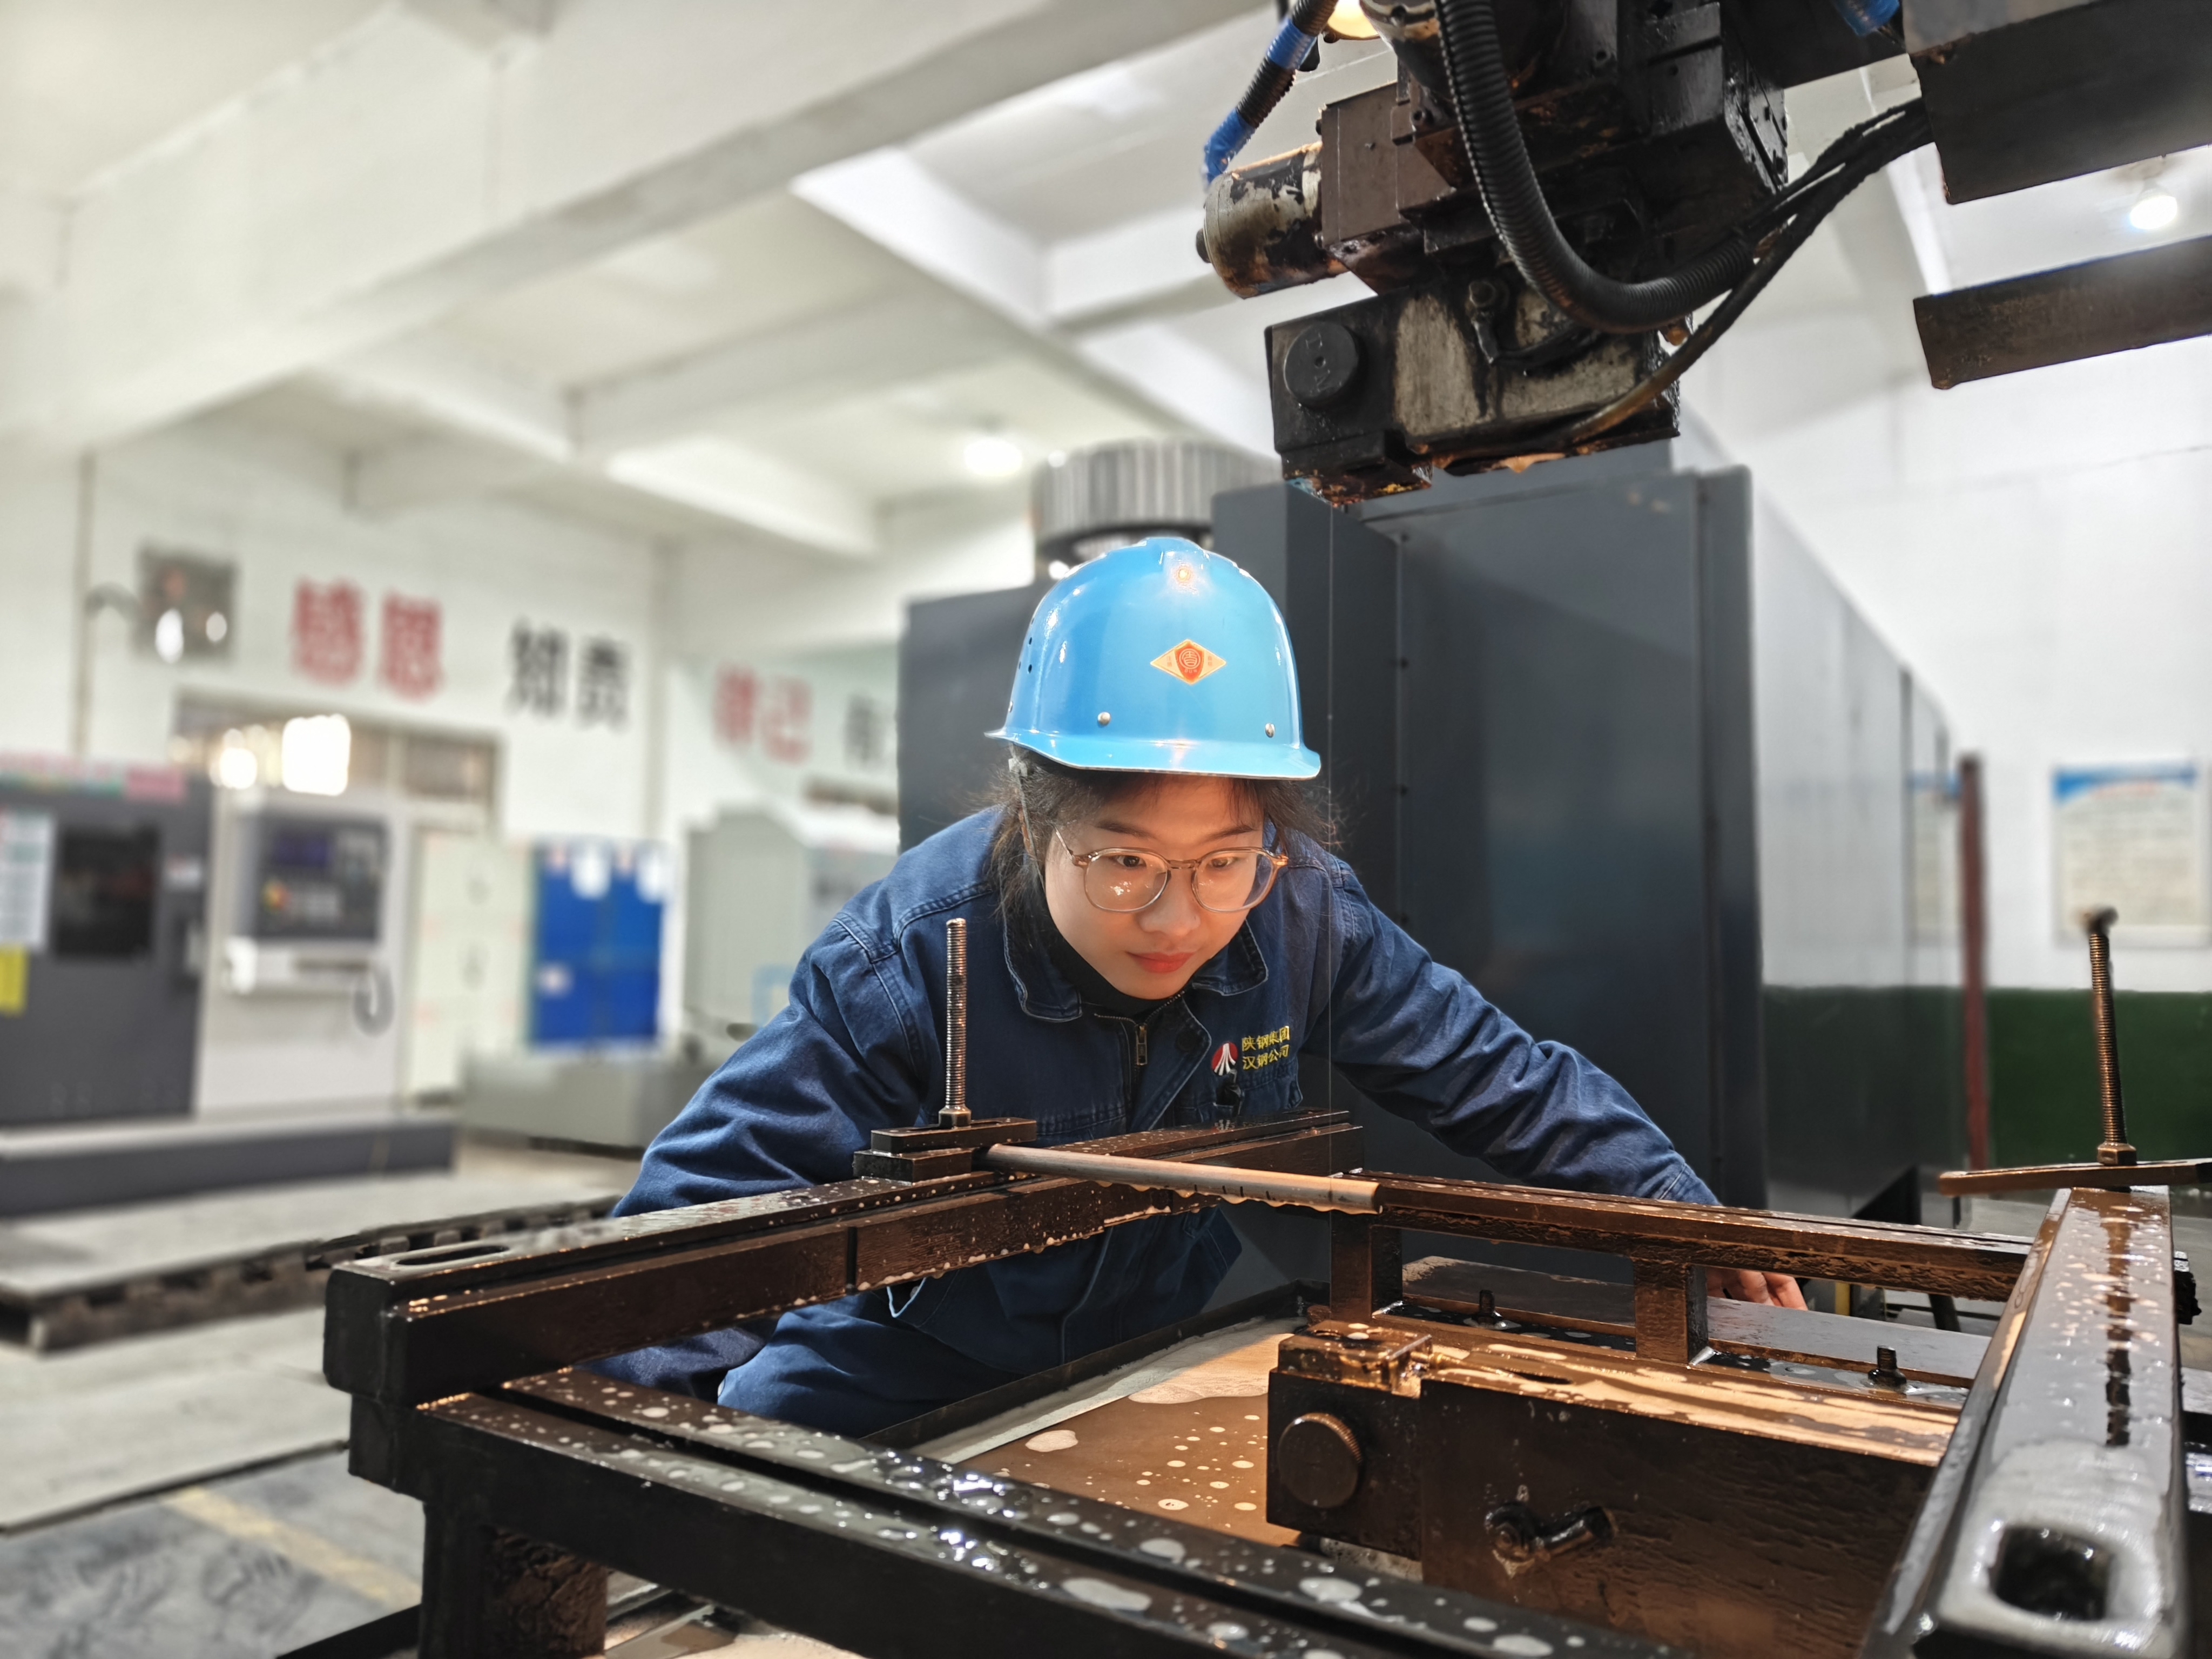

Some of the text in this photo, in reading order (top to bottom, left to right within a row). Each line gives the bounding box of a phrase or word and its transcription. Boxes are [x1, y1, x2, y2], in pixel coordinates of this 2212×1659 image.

[1242, 1026, 1290, 1051] 陕钢集团
[1242, 1044, 1290, 1070] 汉钢公司
